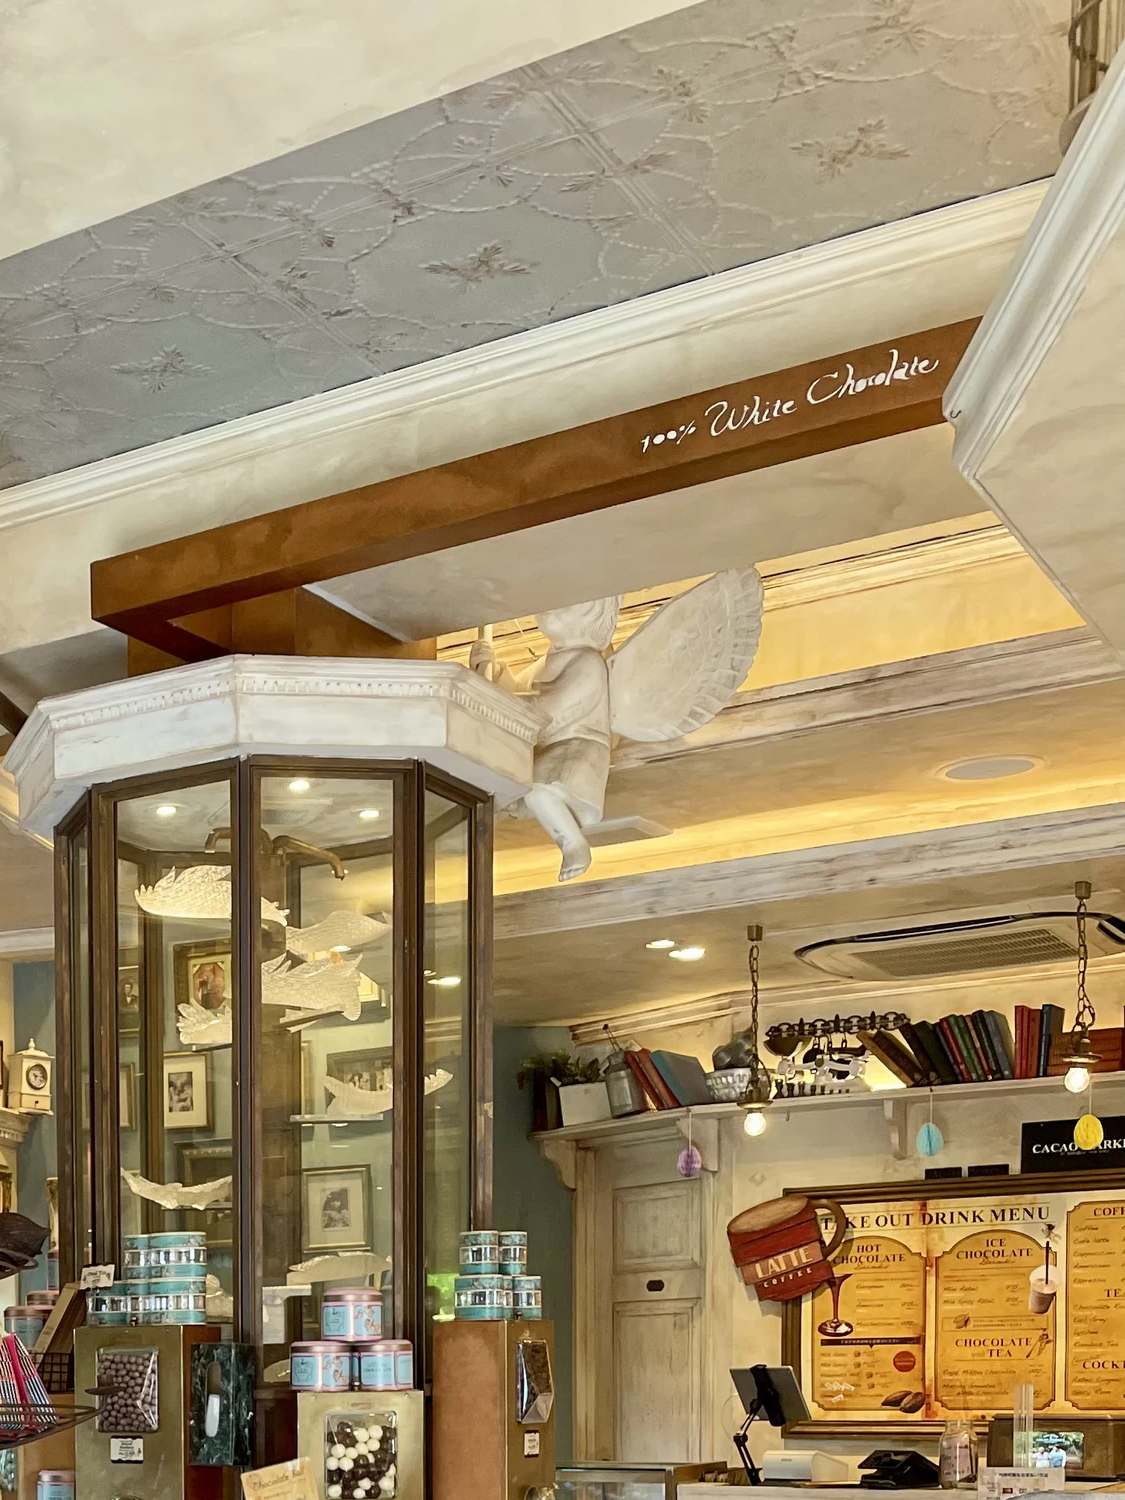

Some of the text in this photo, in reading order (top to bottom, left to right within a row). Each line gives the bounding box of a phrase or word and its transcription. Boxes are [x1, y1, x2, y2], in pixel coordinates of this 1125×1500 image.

[640, 348, 941, 454] 100% White Chocolate
[1032, 1142, 1079, 1154] CACAO
[820, 1206, 1050, 1230] TKE OUT DRINK MENU
[856, 1244, 881, 1253] HOT
[986, 1239, 1007, 1248] ICE
[833, 1253, 906, 1264] CHOCOLATE
[956, 1248, 1034, 1260] CHOCOLATE
[755, 1245, 813, 1279] LATTE
[955, 1337, 1032, 1347] CHOCOLATE
[988, 1349, 1013, 1358] TEA
[252, 1473, 290, 1491] Chocolate
